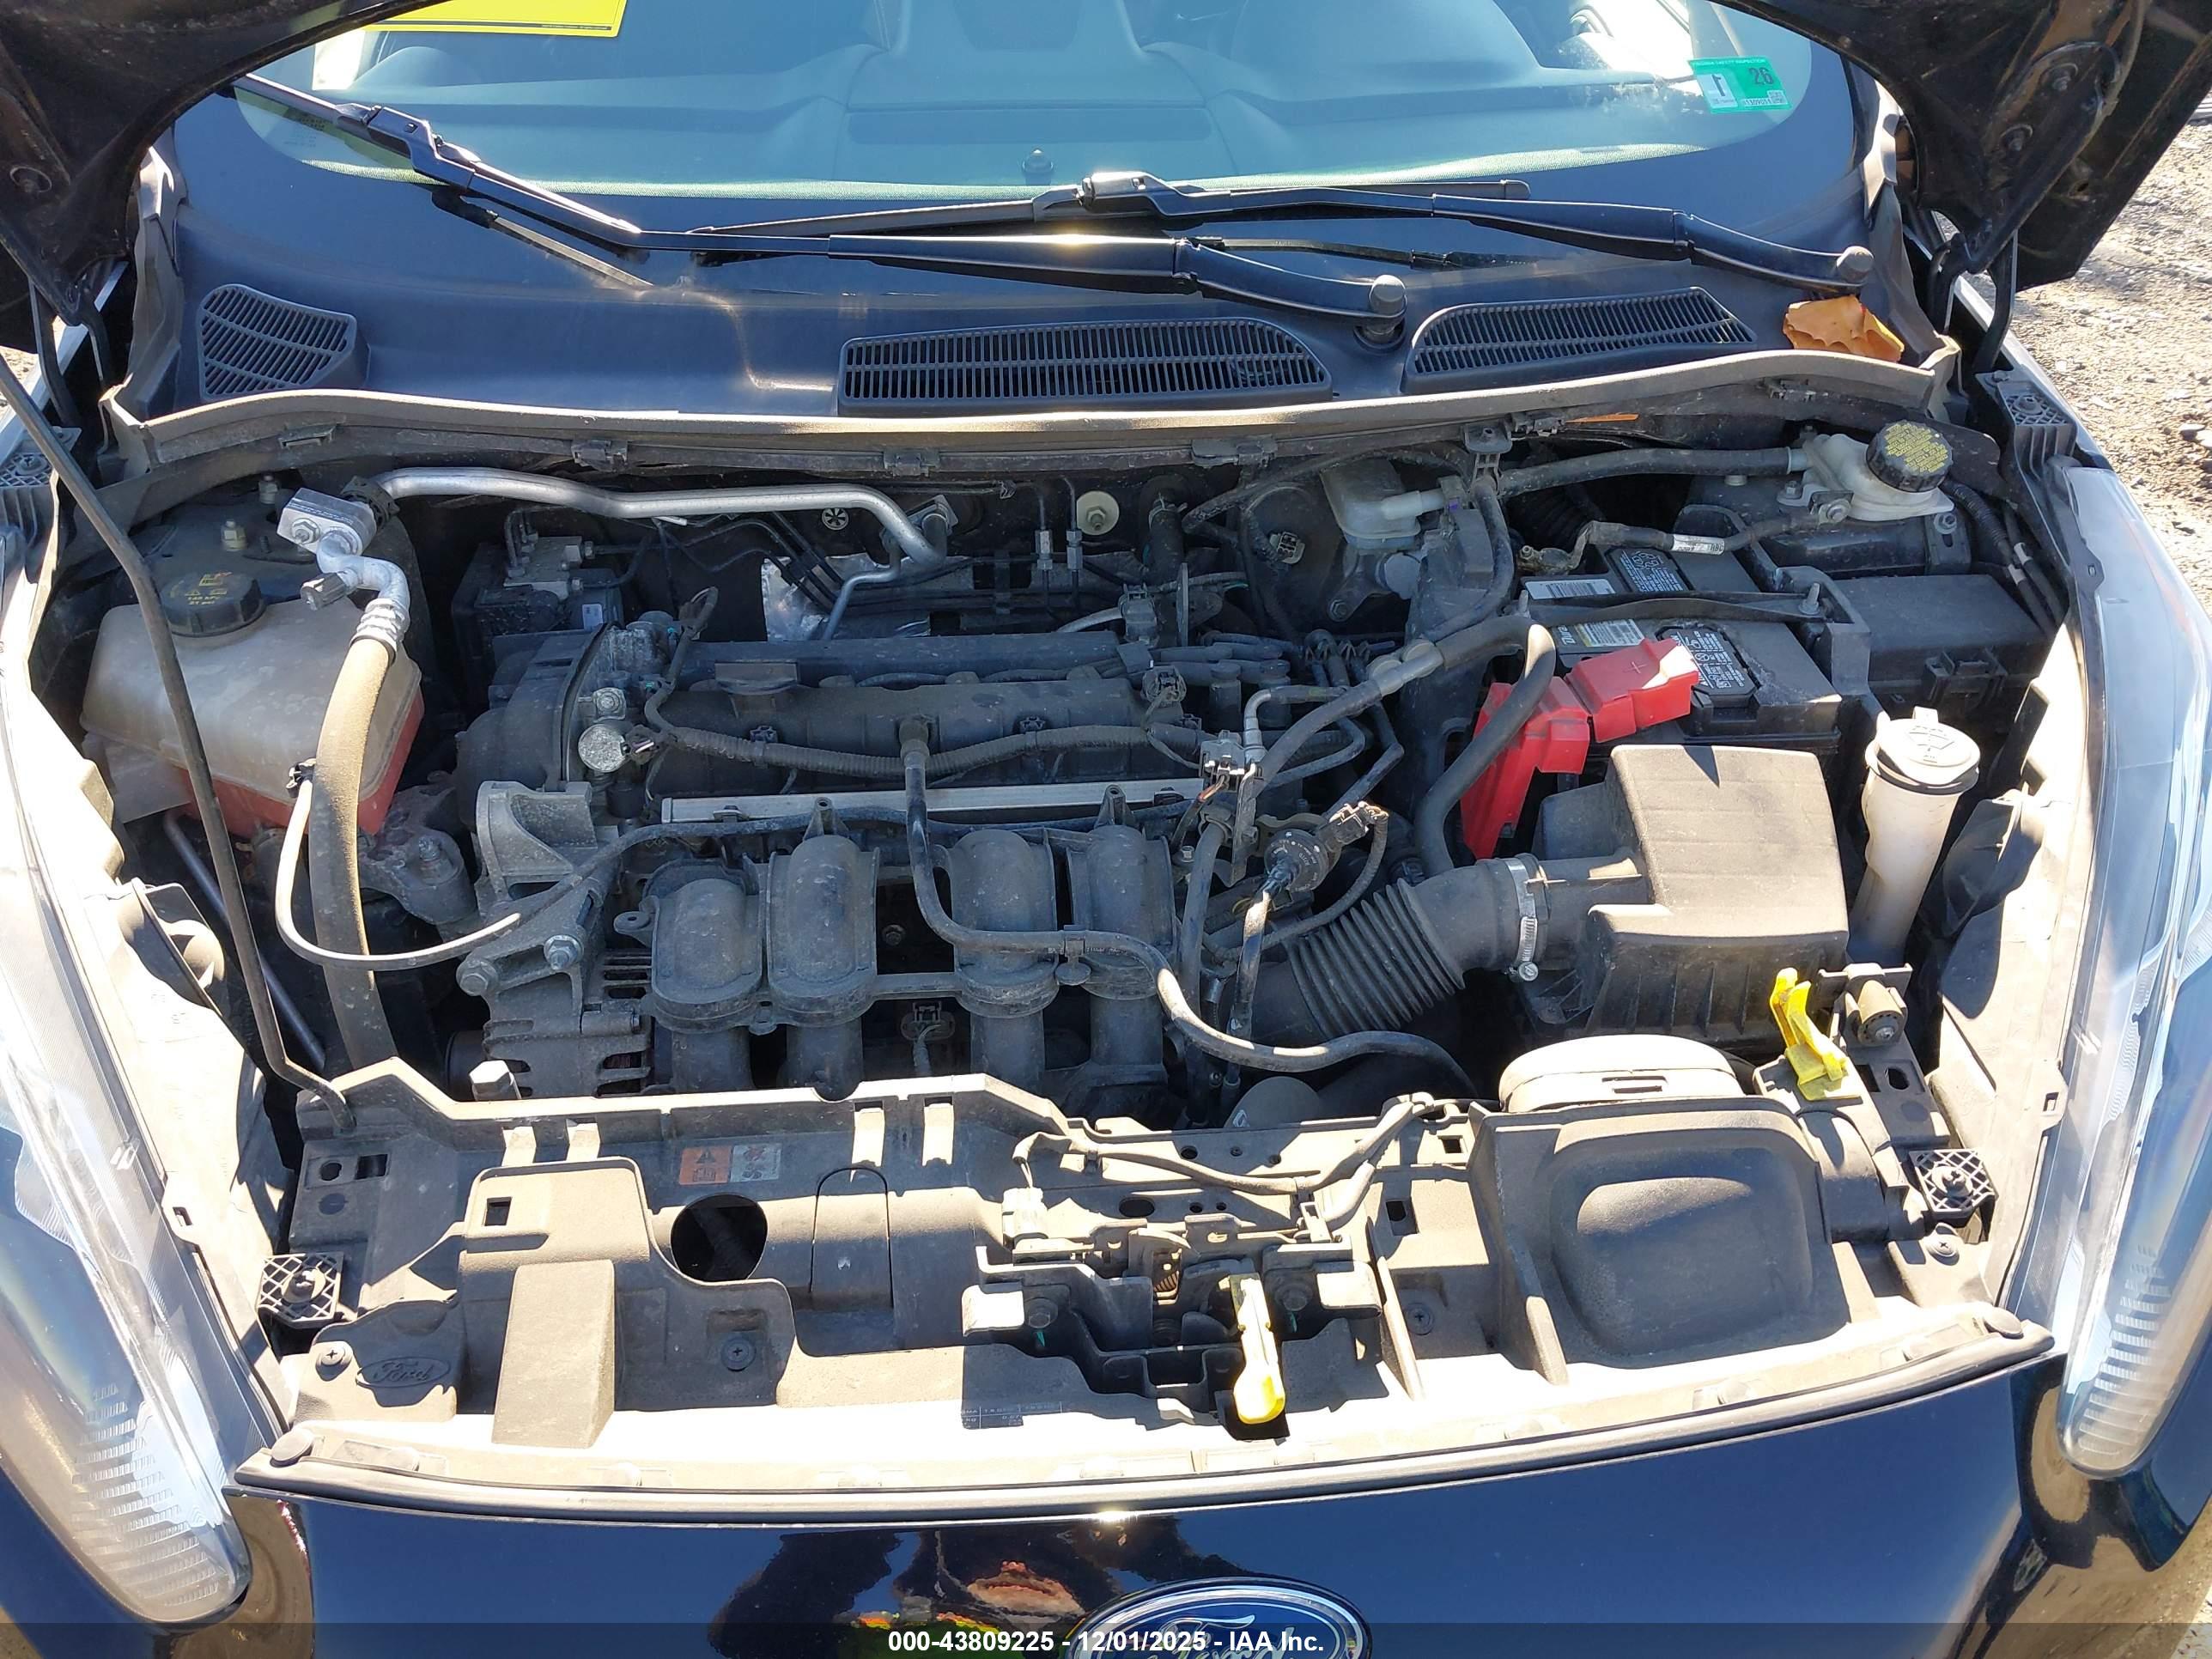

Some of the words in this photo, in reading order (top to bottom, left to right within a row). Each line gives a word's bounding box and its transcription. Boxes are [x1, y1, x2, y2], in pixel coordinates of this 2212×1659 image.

[1748, 67, 1774, 85] 26
[374, 1360, 435, 1382] Ford
[1146, 1614, 1295, 1659] Fd
